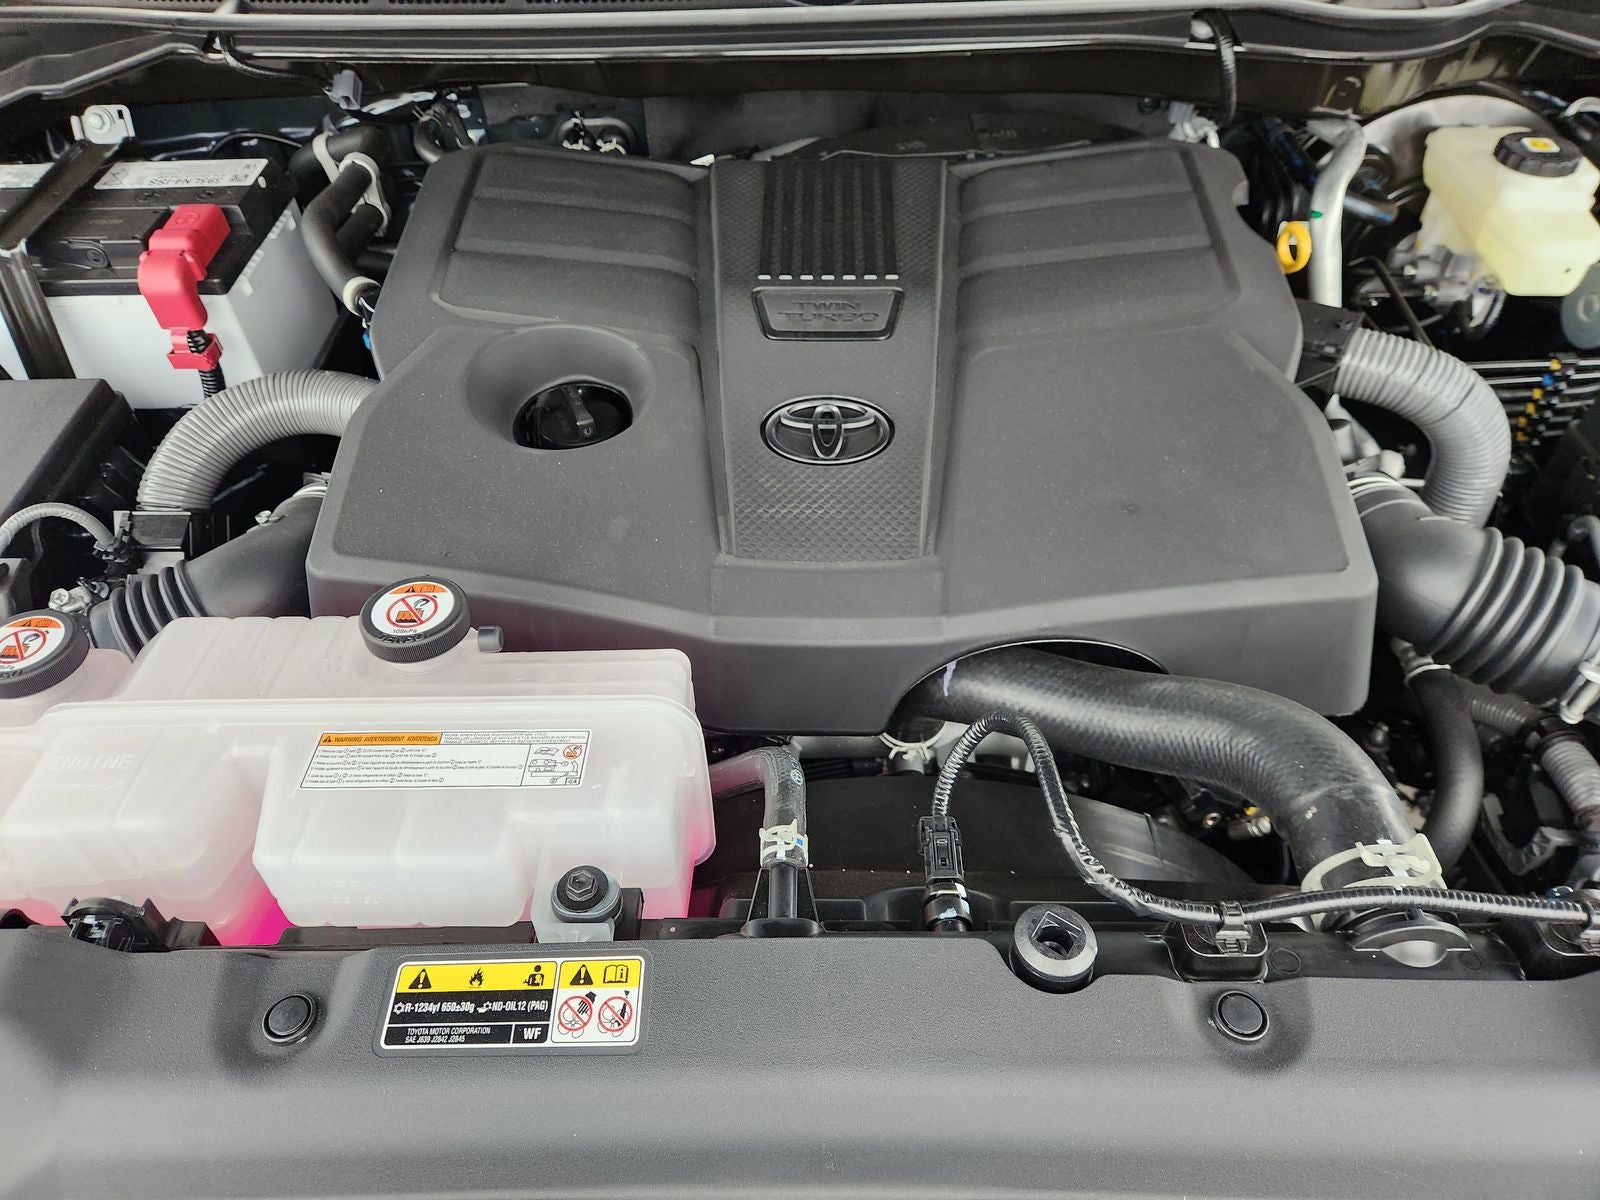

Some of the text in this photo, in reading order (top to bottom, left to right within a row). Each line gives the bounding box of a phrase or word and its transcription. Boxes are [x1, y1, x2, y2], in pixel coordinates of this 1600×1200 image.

[792, 301, 862, 311] TWIN
[778, 311, 880, 322] TURBO
[405, 1002, 441, 1014] R-1234yf
[441, 1001, 475, 1014] 650±30g
[527, 1000, 549, 1013] (PAG)
[407, 1026, 491, 1036] TOYOTA MOTOR CORPORATION
[523, 1027, 542, 1040] WF
[405, 1035, 417, 1044] SAE
[416, 1035, 431, 1044] J639
